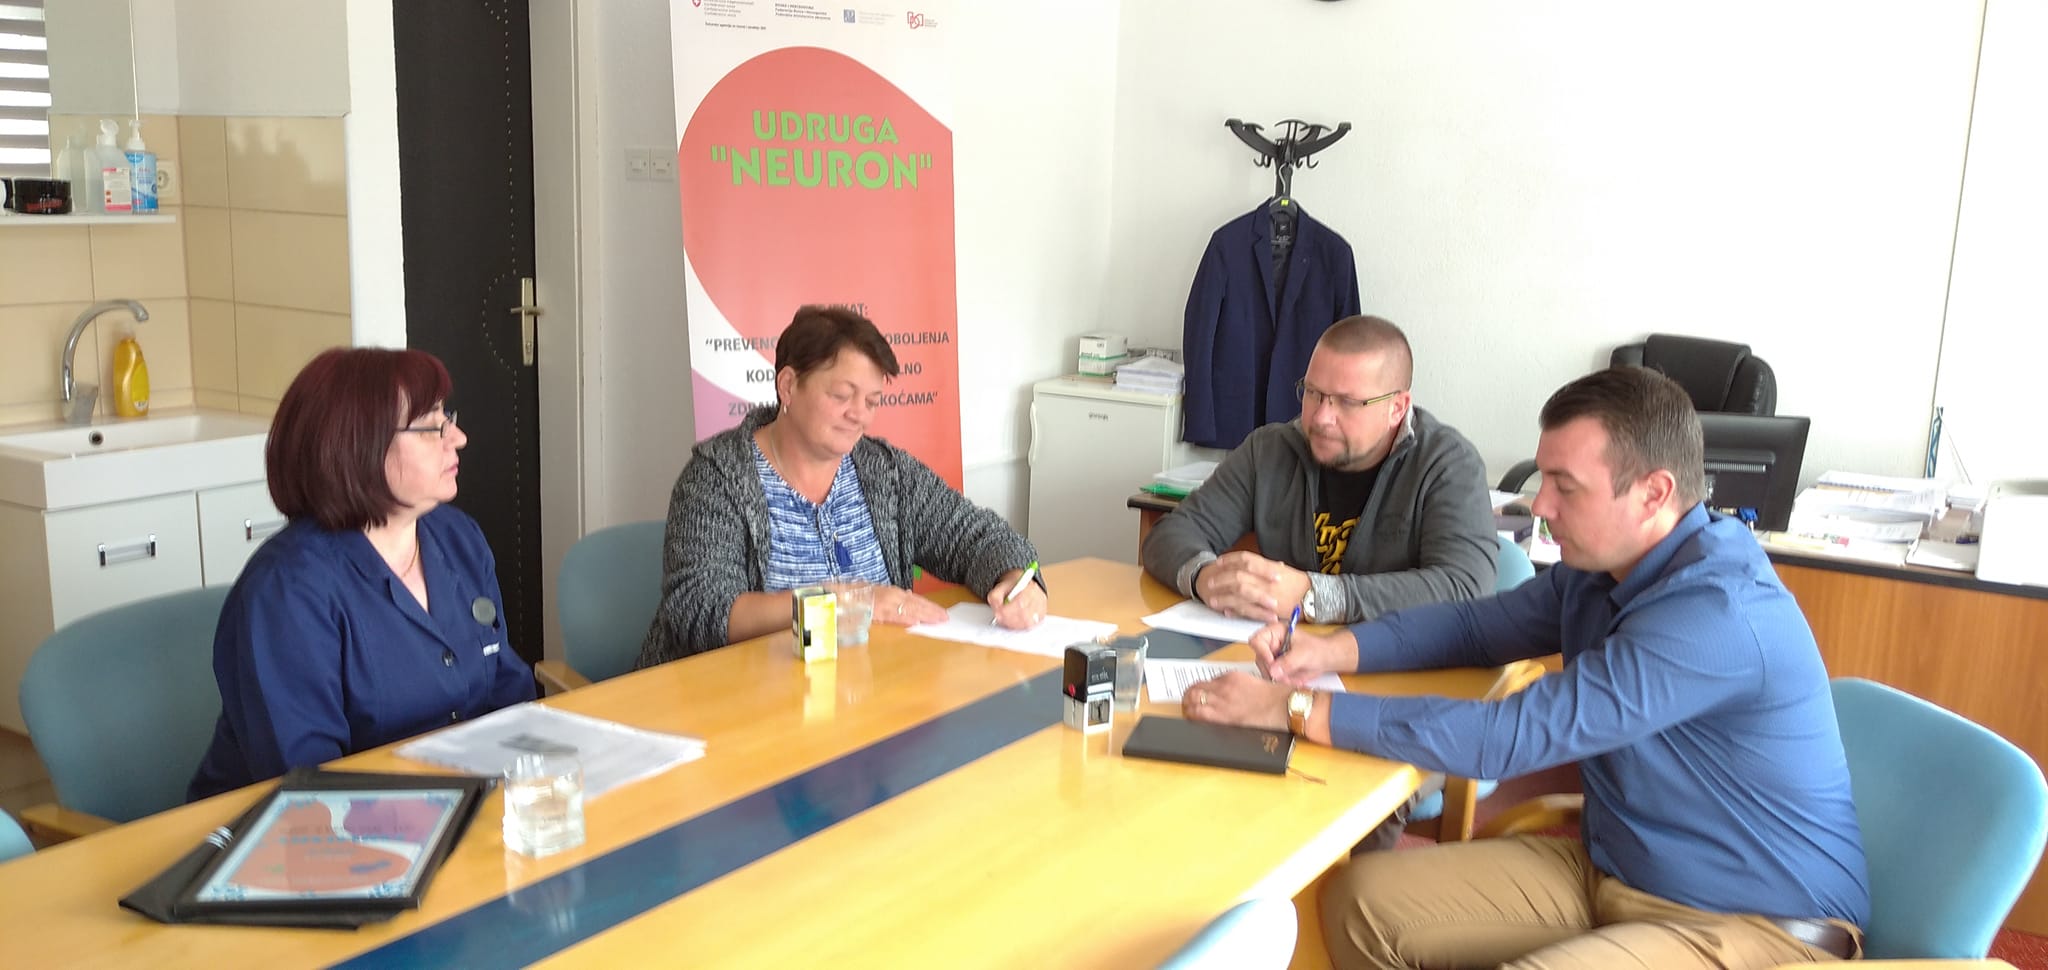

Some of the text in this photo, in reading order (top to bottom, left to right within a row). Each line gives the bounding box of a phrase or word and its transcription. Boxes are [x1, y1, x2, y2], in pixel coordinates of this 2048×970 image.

[752, 110, 899, 144] UDRUGA
[710, 145, 933, 190] "NEURON"
[705, 336, 780, 352] “PREVENC
[746, 369, 776, 383] KOD
